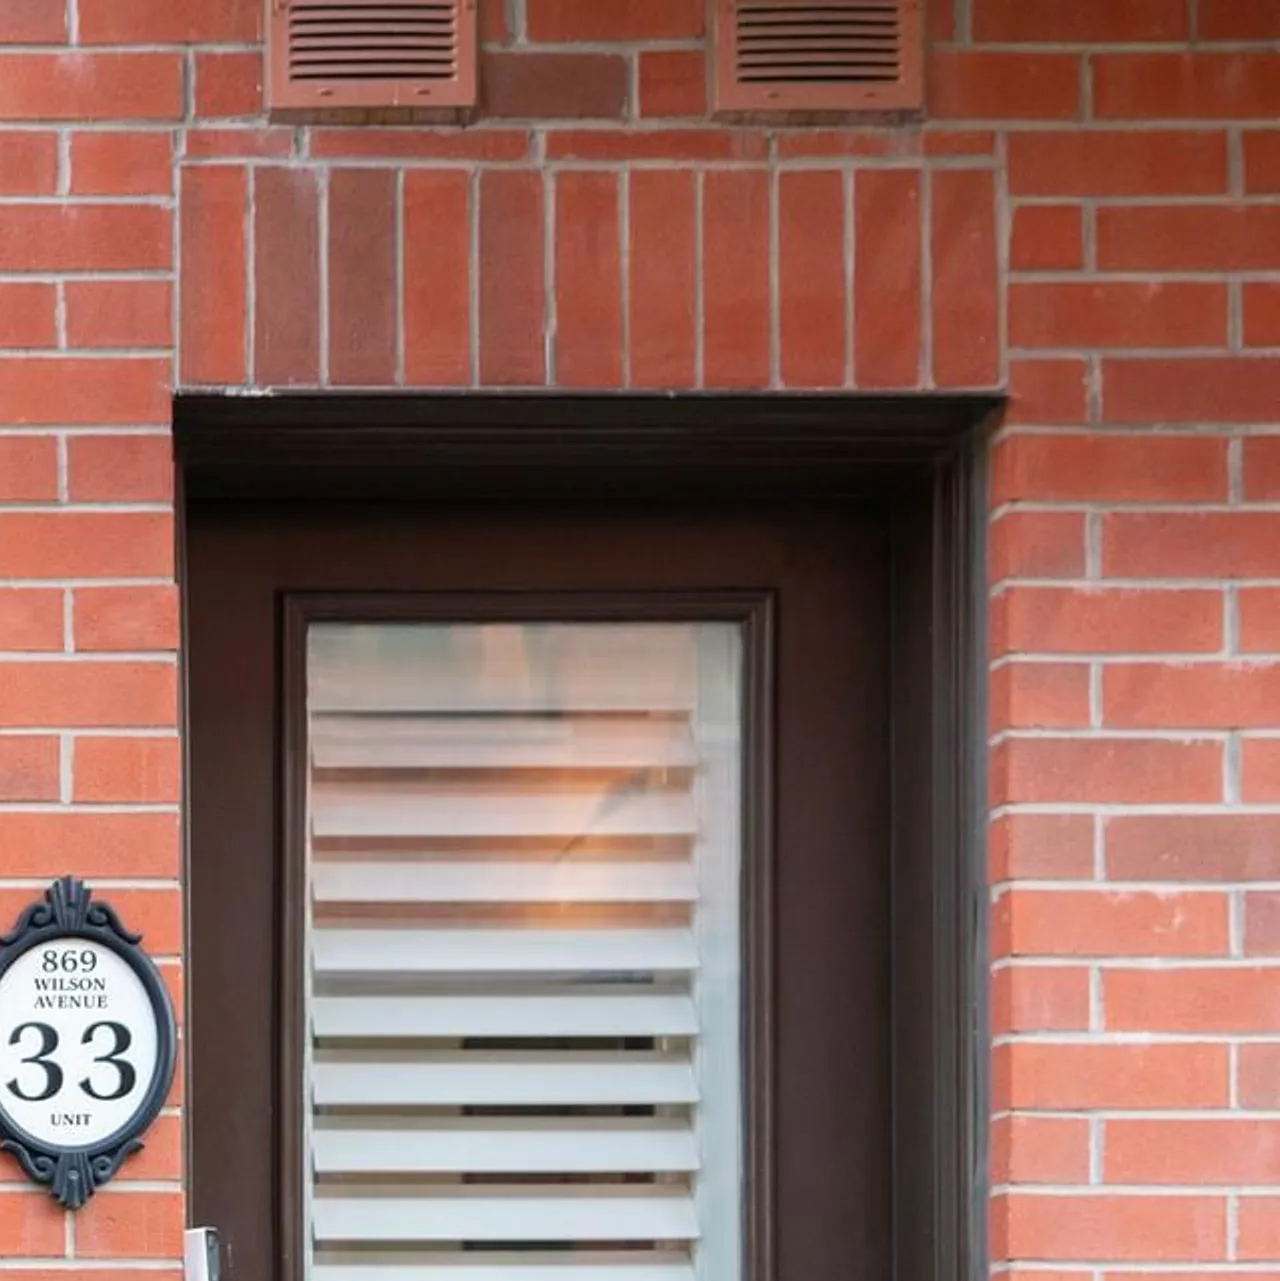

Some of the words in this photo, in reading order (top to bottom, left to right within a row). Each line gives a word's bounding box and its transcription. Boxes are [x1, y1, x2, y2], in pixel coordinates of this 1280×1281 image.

[42, 950, 97, 973] 869
[34, 978, 107, 991] WILSON
[34, 995, 109, 1009] AVENUE
[6, 1021, 137, 1101] 33
[50, 1113, 92, 1126] UNIT
